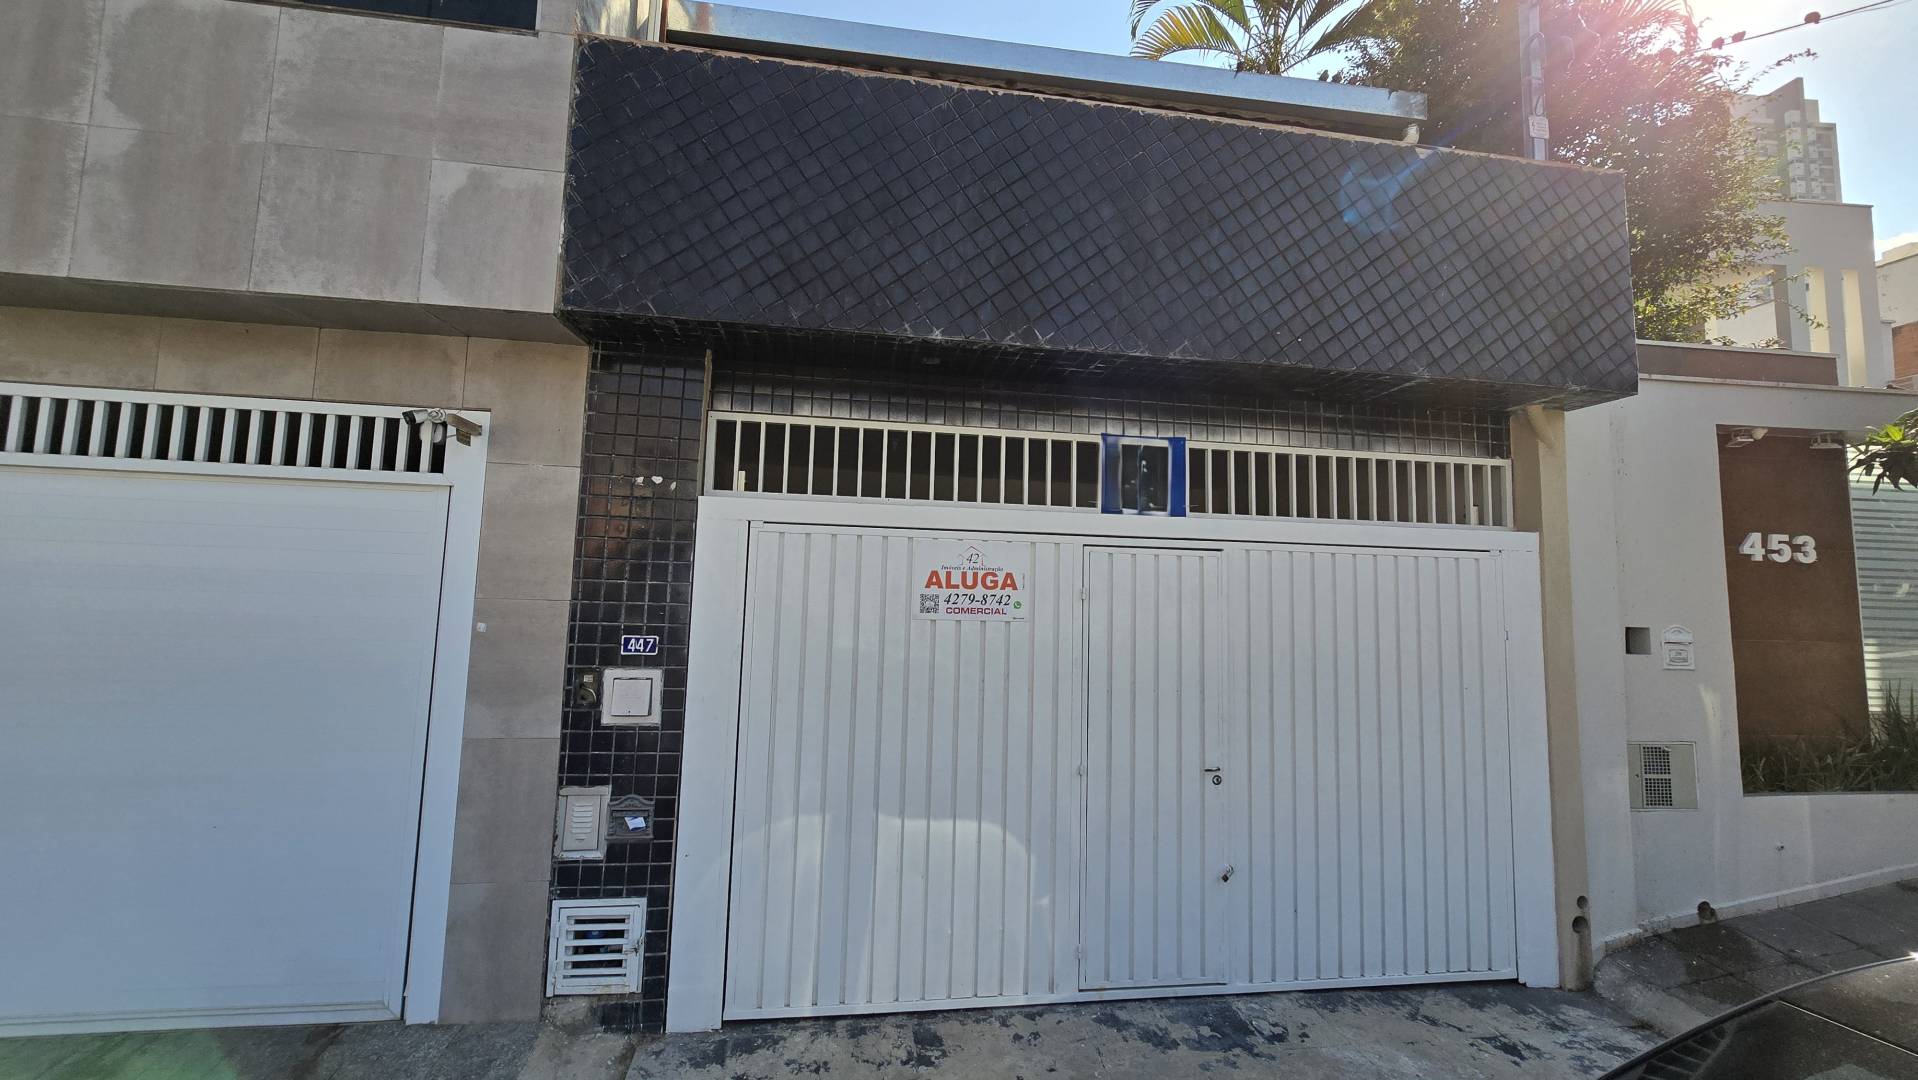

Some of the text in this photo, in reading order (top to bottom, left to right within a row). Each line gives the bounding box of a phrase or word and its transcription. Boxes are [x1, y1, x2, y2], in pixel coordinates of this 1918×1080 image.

[1739, 532, 1818, 564] 453
[966, 553, 979, 564] 42
[925, 570, 1018, 591] ALUGA
[943, 592, 1011, 606] 4279-8742
[945, 607, 1007, 616] COMERCIAL
[627, 638, 654, 652] 447
